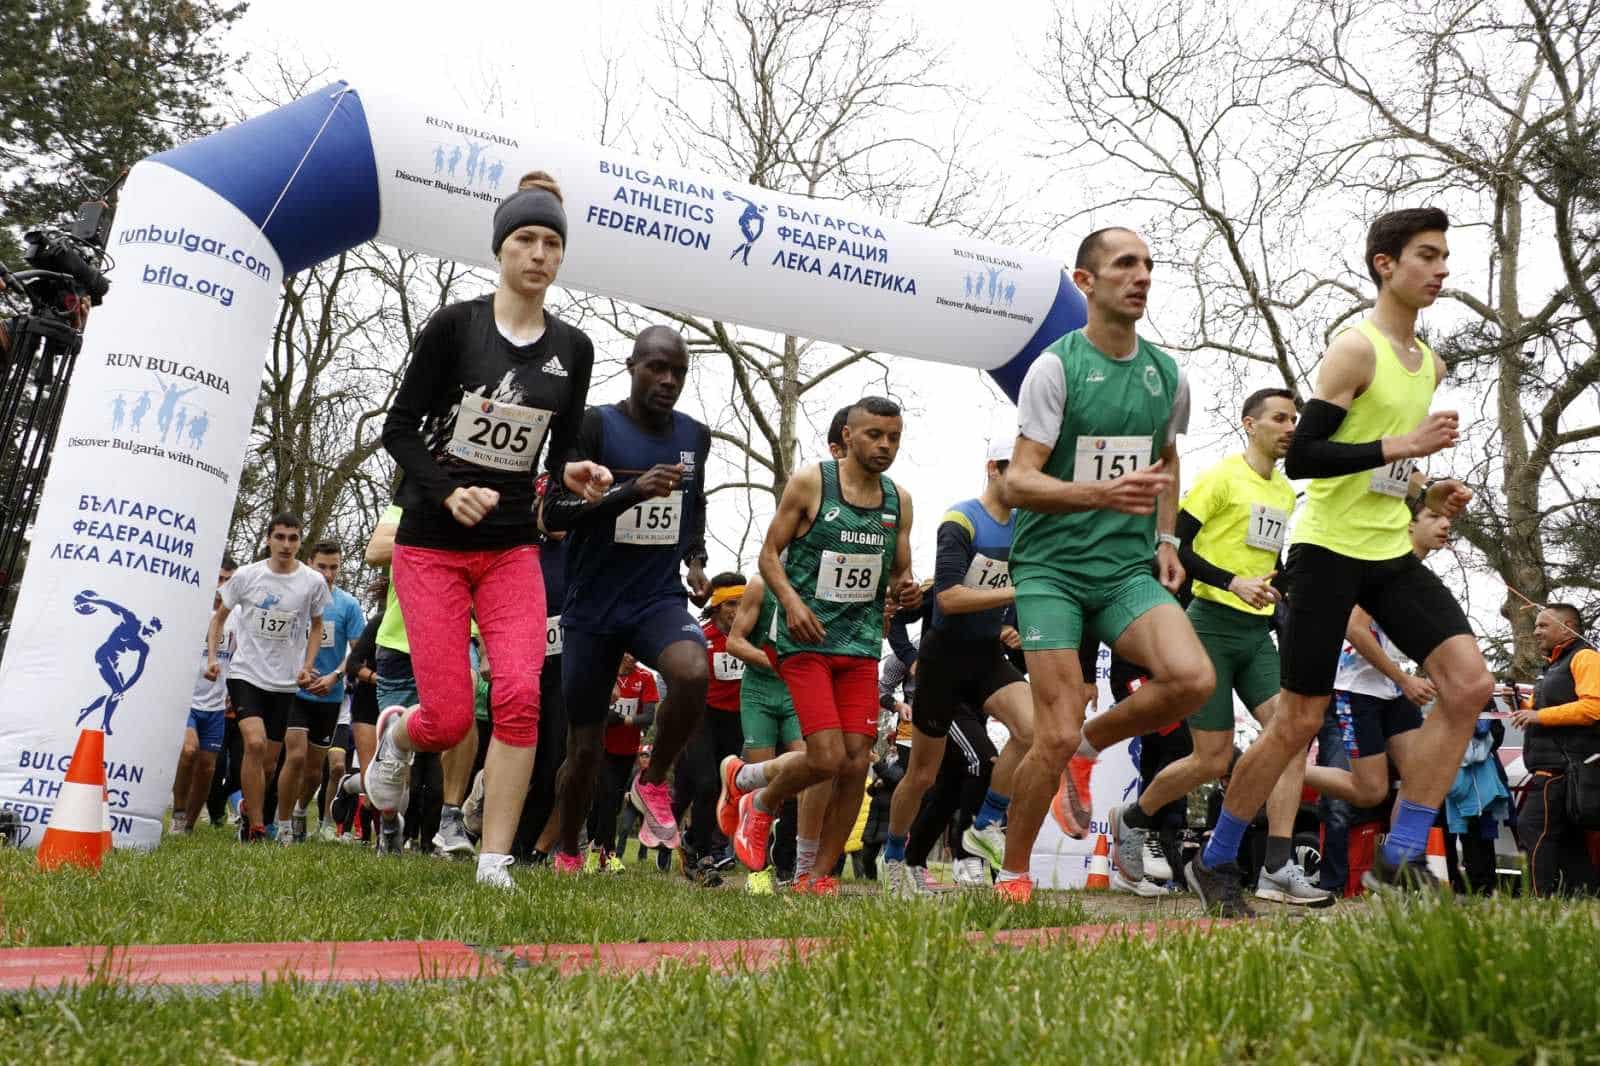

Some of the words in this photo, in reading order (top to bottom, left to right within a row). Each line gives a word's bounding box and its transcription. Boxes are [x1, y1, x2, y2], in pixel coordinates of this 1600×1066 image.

[425, 115, 454, 131] RUN
[456, 124, 519, 149] BULGARIA
[395, 169, 434, 187] Discover
[434, 179, 471, 195] Bulgaria
[472, 190, 492, 203] with
[599, 160, 715, 200] BULGARIAN
[614, 186, 715, 224] ATHLETICS
[777, 205, 887, 241] БЪЛГАРСКА
[587, 205, 711, 251] FEDERATION
[777, 225, 888, 264] ФЕДЕРАЦИЯ
[119, 225, 271, 283] runbulgar.com
[772, 250, 822, 275] ЛЕКА
[828, 262, 917, 295] АТЛЕТИКА
[143, 264, 234, 306] bfla.org
[106, 353, 143, 368] RUN
[147, 357, 231, 395] BULGARIA
[468, 417, 532, 453] 205
[68, 436, 111, 448] Discover
[111, 438, 166, 455] Bulgaria
[168, 450, 194, 467] with
[195, 460, 230, 484] running
[1094, 455, 1138, 480] 151
[79, 495, 197, 535] БЪЛГАРСКА
[634, 505, 673, 529] 155
[1258, 516, 1282, 539] 177
[73, 519, 194, 558] ФЕДЕРАЦИЯ
[840, 530, 884, 546] BULGARIA
[50, 543, 100, 563] ЛЕКА
[108, 549, 201, 588] АТЛЕТИКА
[834, 567, 872, 589] 158
[978, 569, 1009, 589] 148
[261, 617, 286, 631] 137
